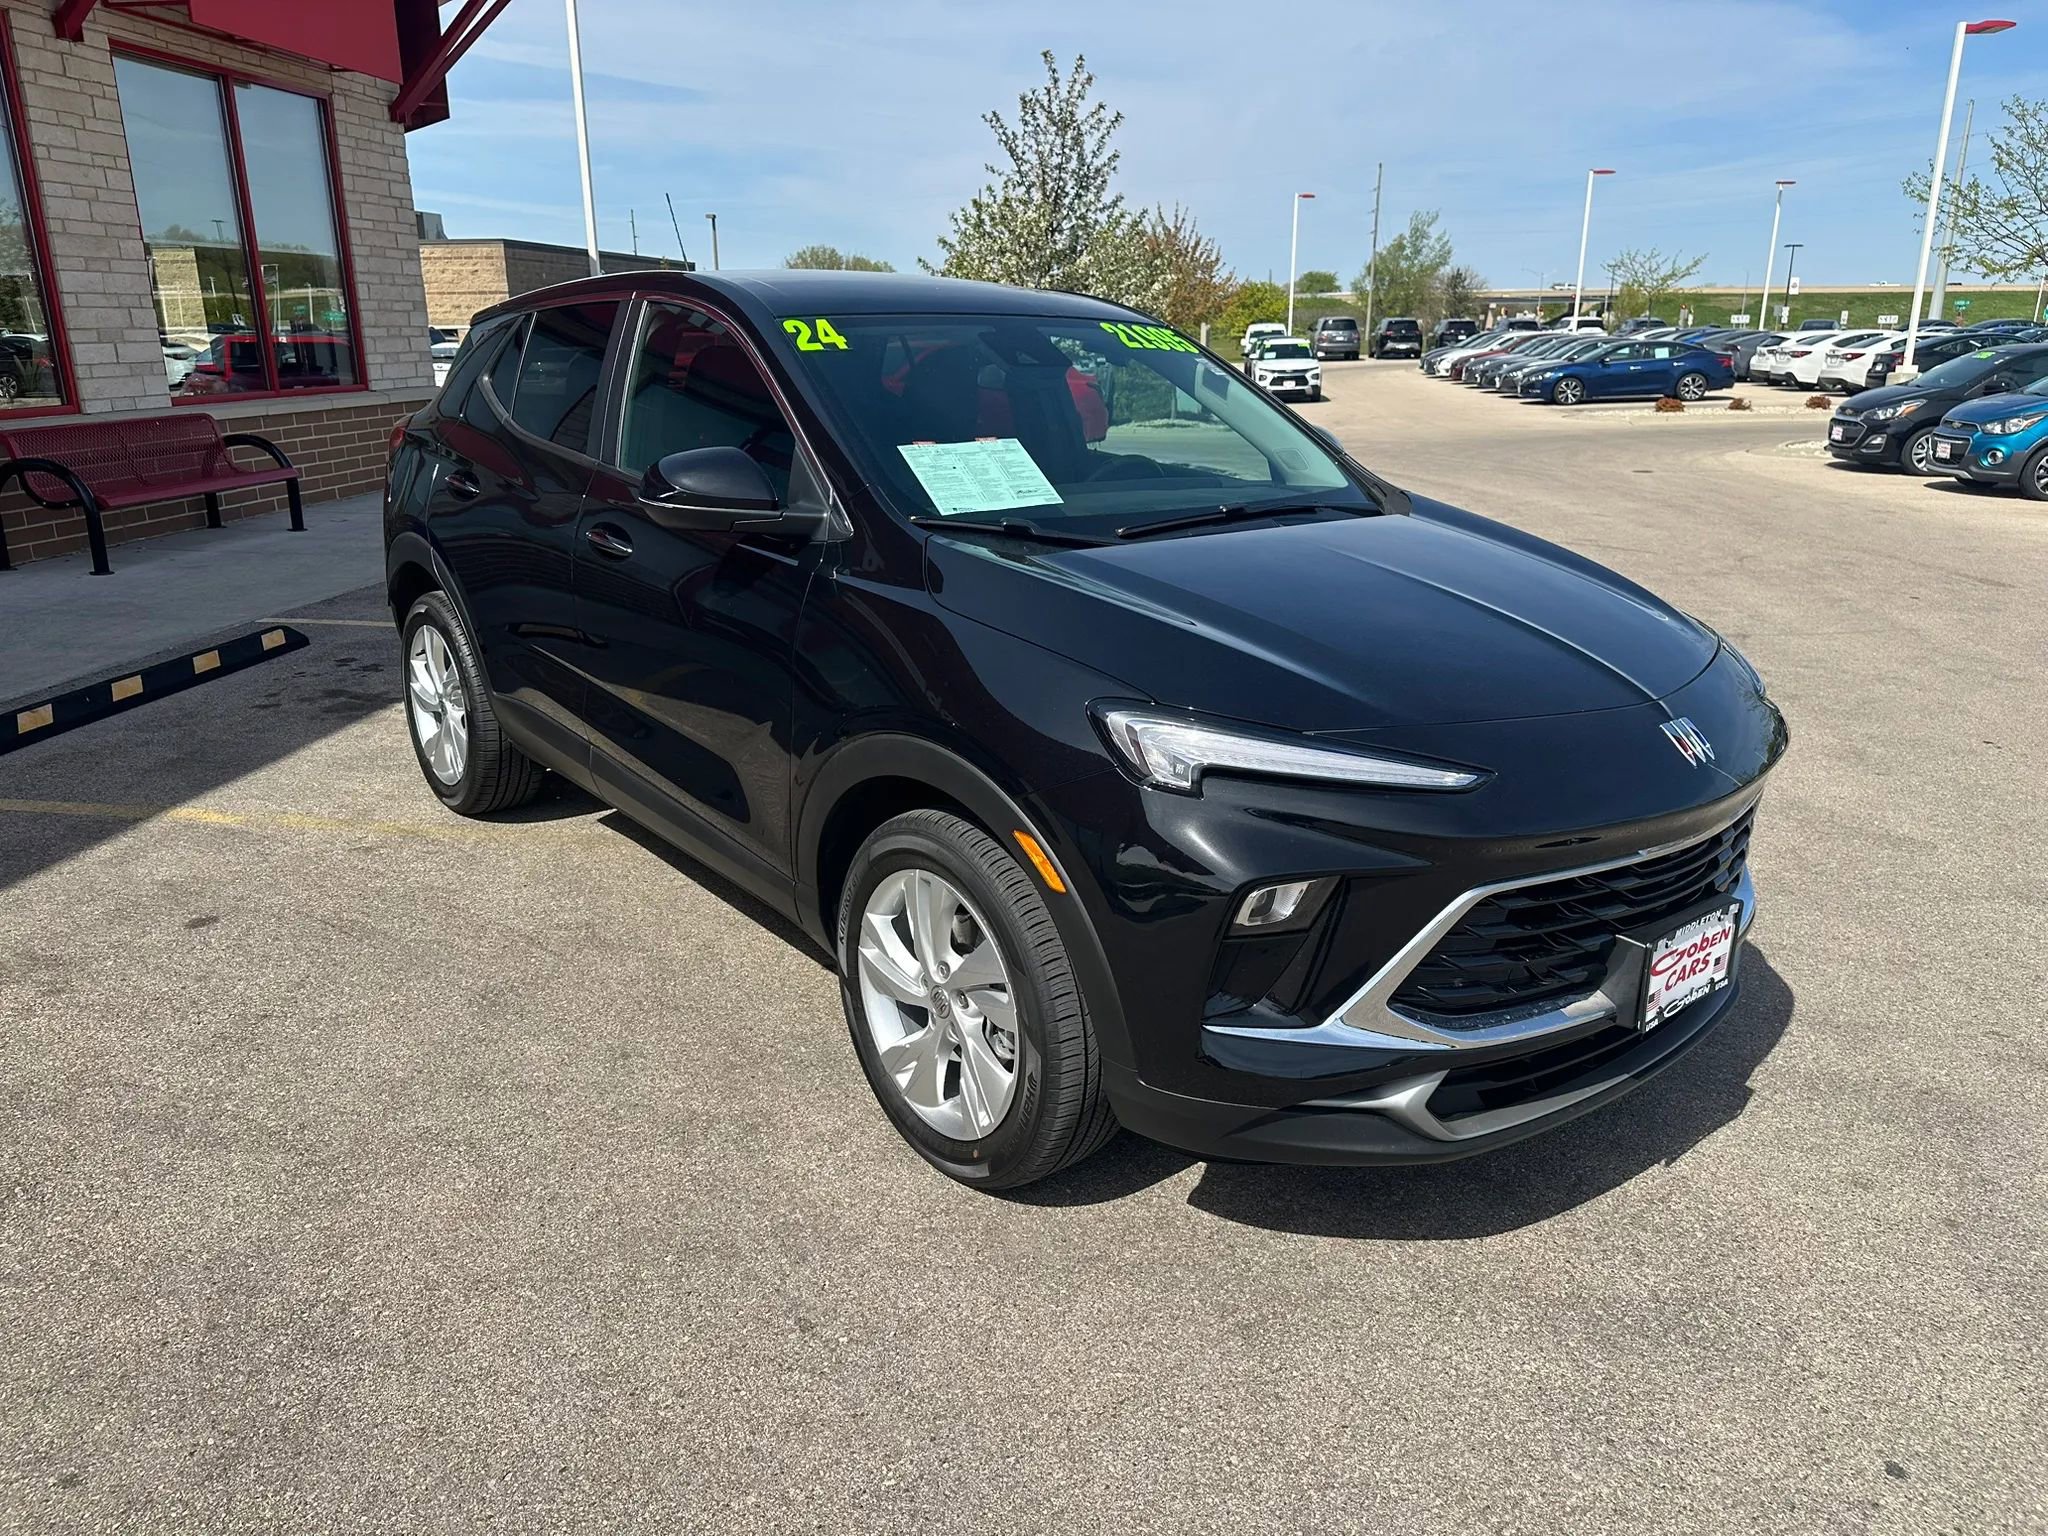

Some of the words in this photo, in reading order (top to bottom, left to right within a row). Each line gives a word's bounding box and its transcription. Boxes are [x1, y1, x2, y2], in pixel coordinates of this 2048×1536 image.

[783, 319, 849, 351] 24
[1099, 322, 1200, 354] 21995
[1675, 908, 1722, 937] MIDDLETON
[1664, 951, 1712, 992] CARS
[1646, 1018, 1659, 1032] USA
[1715, 978, 1729, 991] USA
